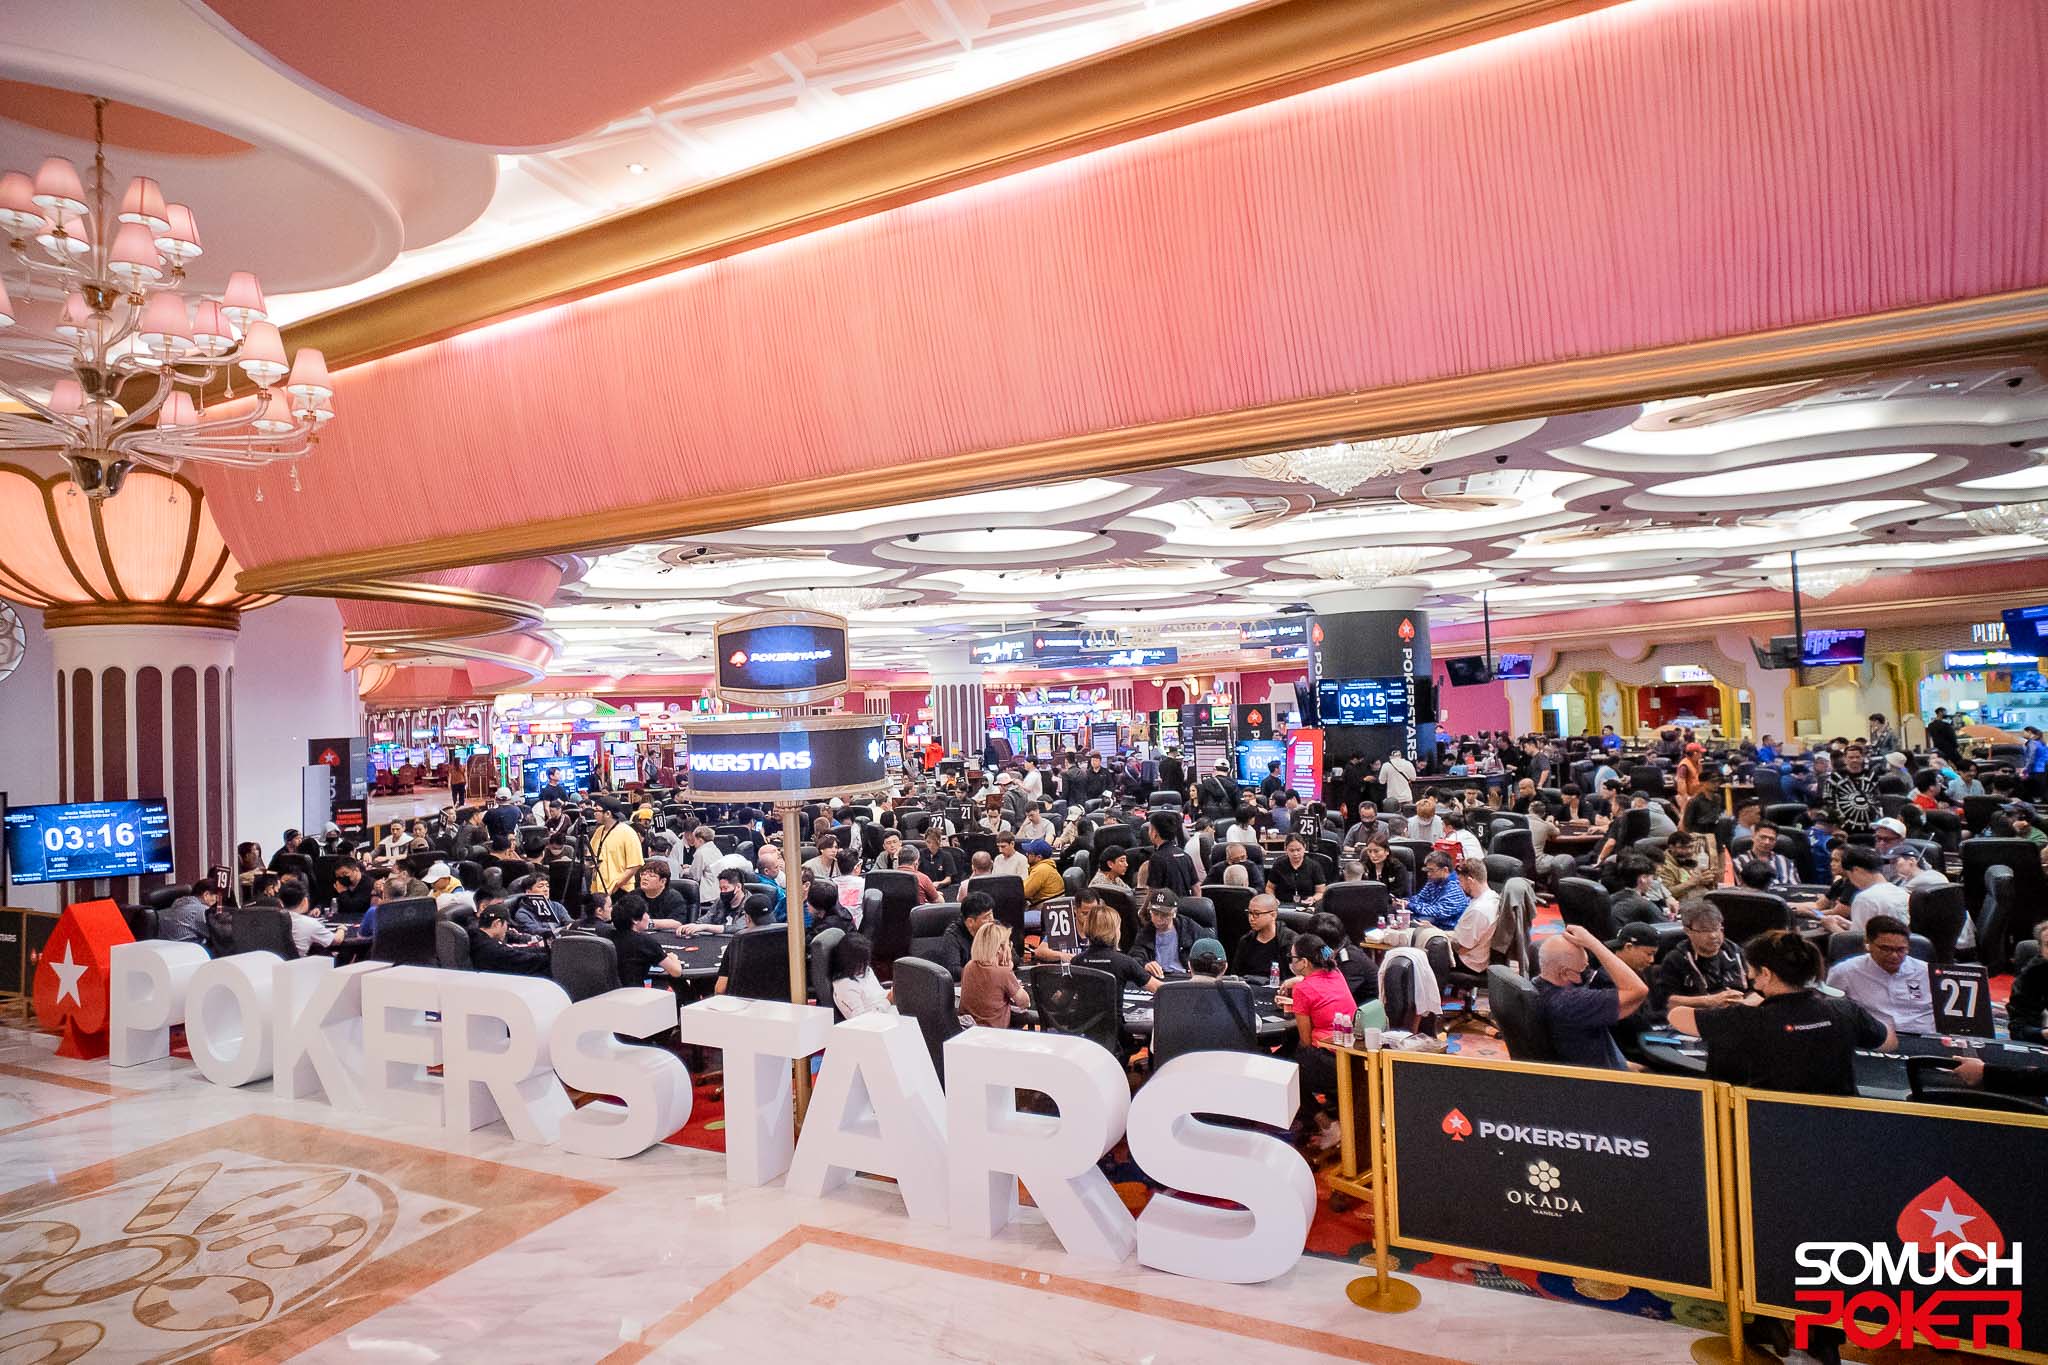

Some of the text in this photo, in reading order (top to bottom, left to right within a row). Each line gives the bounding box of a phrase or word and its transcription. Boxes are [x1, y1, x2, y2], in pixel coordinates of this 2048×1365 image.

[1971, 622, 2010, 643] PLAY
[750, 649, 832, 662] POKERSTARS
[1340, 692, 1386, 708] 03:15
[1402, 648, 1418, 762] POKERSTARS
[931, 815, 945, 830] 22
[961, 806, 971, 820] 21
[44, 822, 135, 851] 03:16
[1300, 818, 1314, 835] 25
[216, 871, 229, 889] 19
[531, 899, 552, 917] 23
[1048, 910, 1071, 937] 26
[1940, 978, 1978, 1018] 27
[110, 940, 1317, 1284] POKERSTARS
[1478, 1120, 1650, 1159] POKERSTARS
[1507, 1190, 1584, 1214] OKADA
